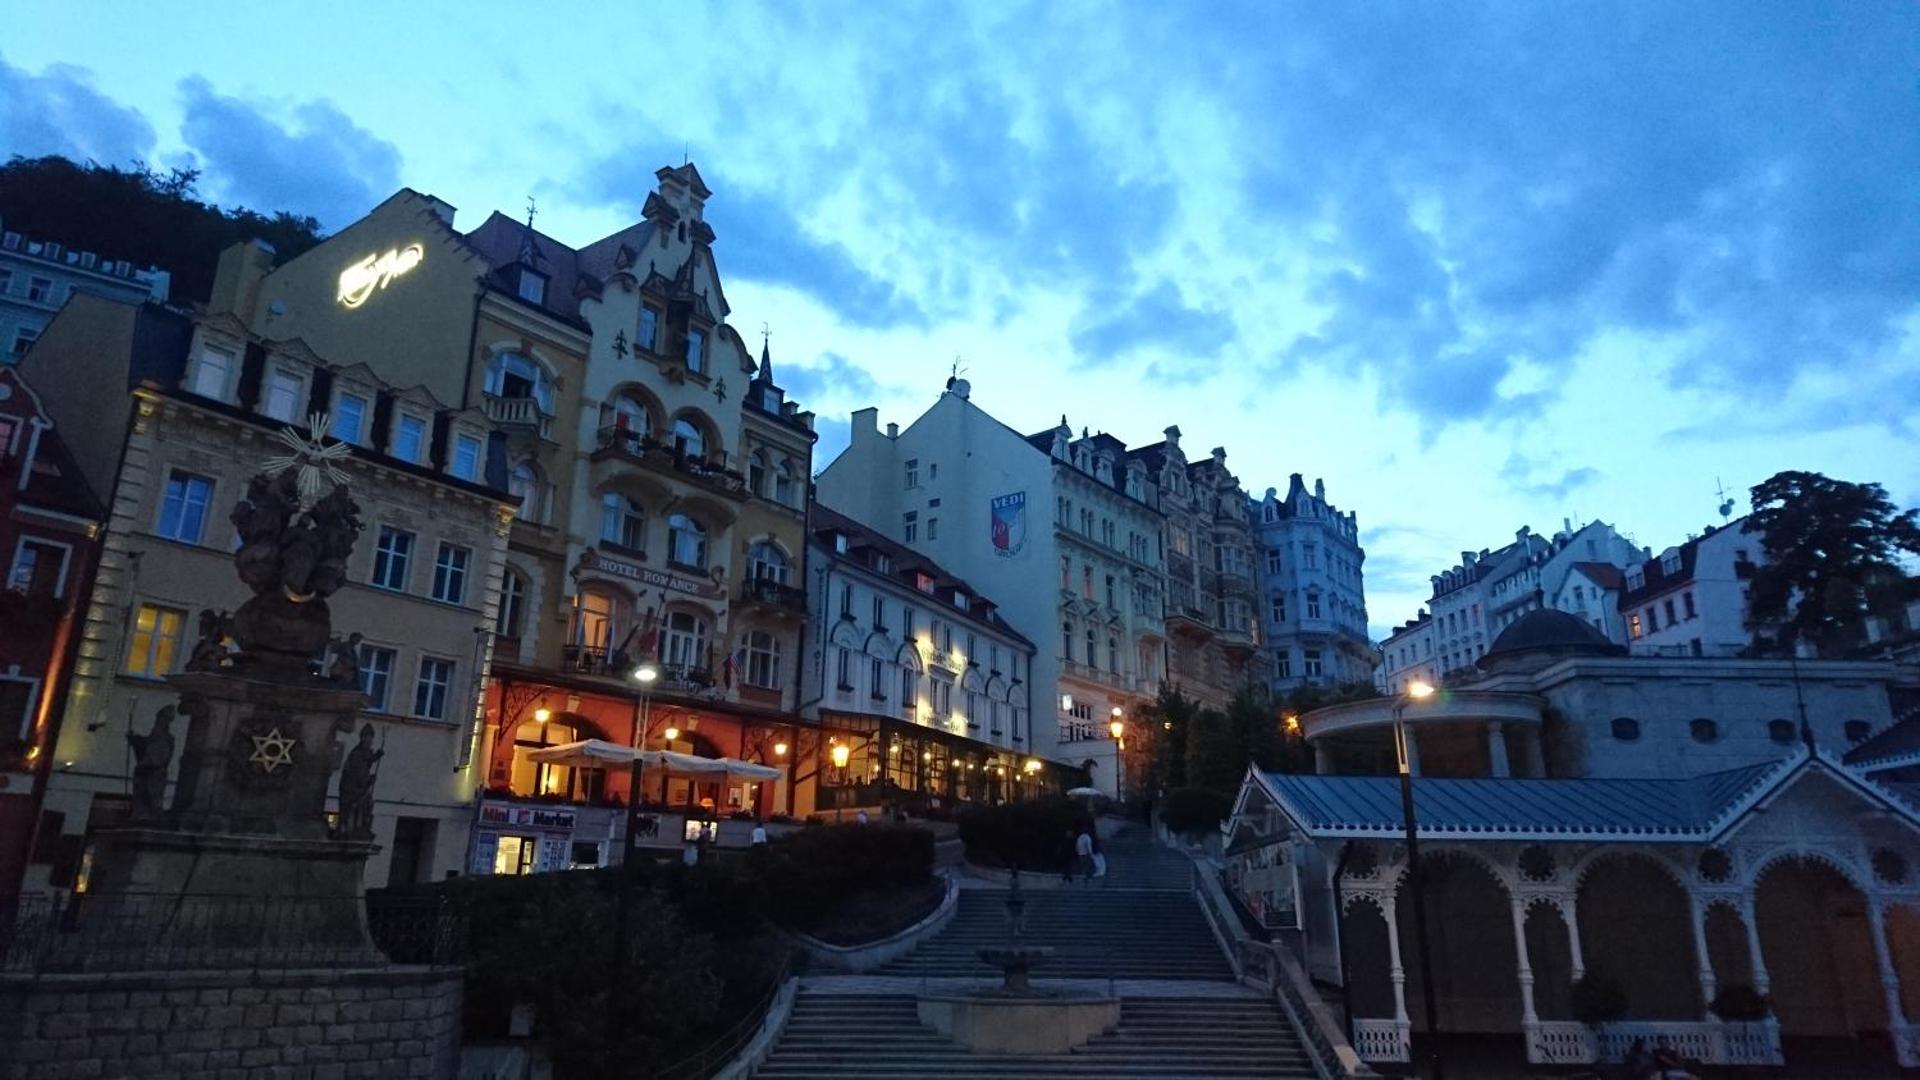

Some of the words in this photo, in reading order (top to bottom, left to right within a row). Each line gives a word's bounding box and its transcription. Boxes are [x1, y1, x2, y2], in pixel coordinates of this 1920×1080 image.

[993, 493, 1025, 509] VEDI
[598, 559, 640, 578] HOTEL
[644, 571, 699, 593] ROMANCE
[482, 806, 510, 823] Mini
[533, 810, 574, 828] Market
